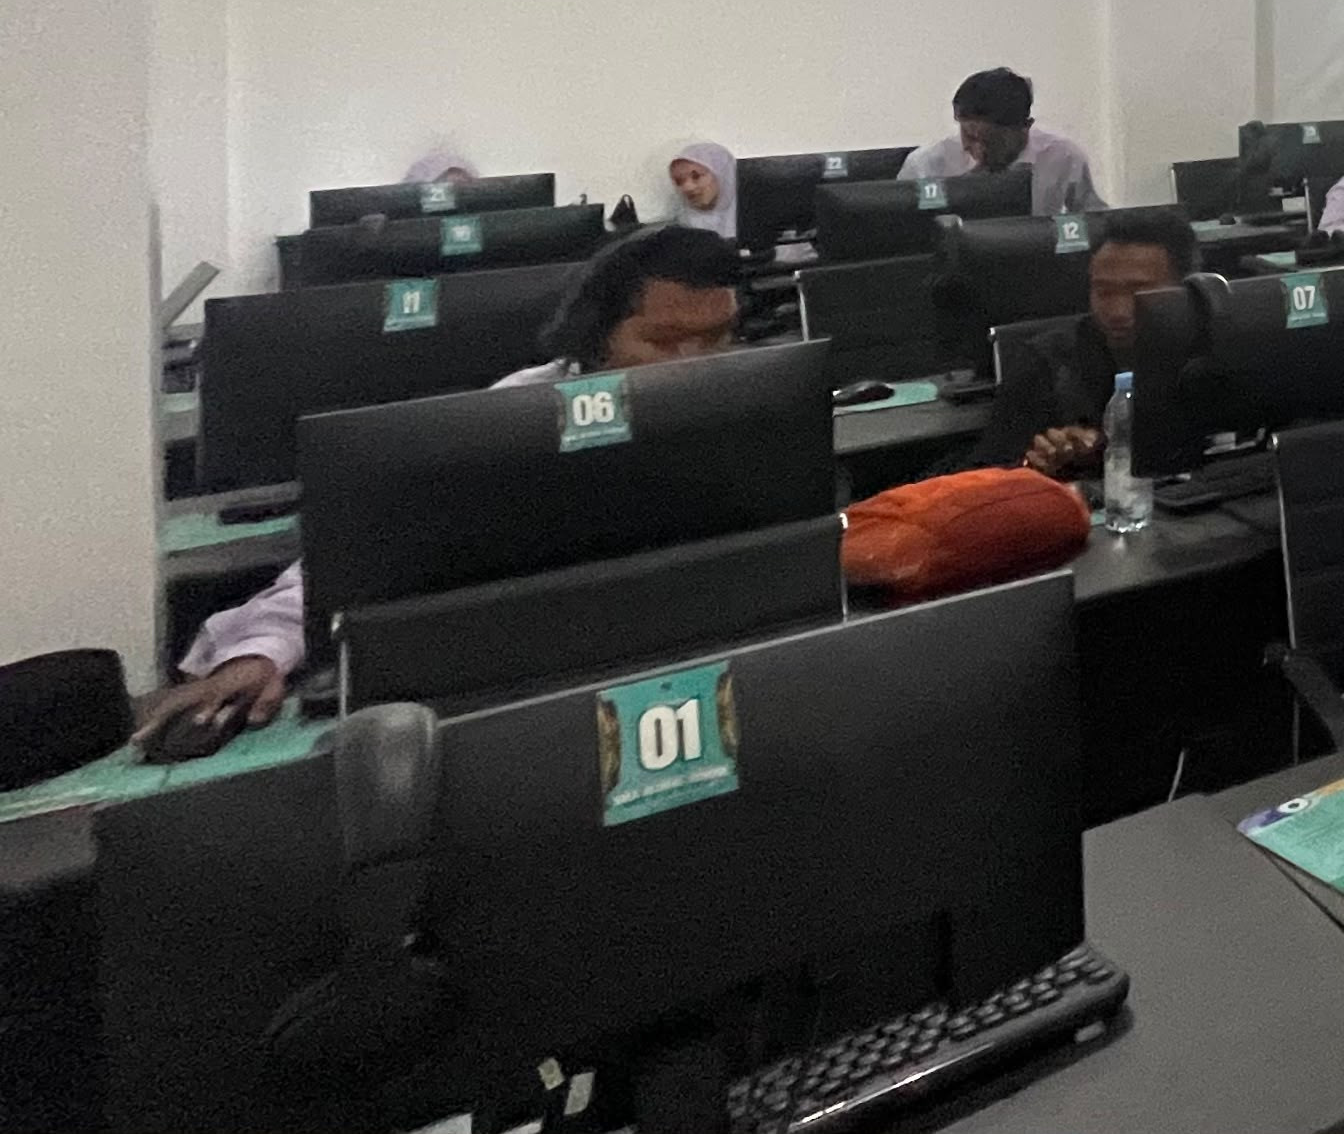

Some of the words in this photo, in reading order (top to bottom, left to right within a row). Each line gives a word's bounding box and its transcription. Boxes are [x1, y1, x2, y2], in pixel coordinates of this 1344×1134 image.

[1062, 221, 1080, 240] 12
[1293, 285, 1316, 311] 07
[573, 391, 615, 426] 06
[638, 698, 702, 771] 01
